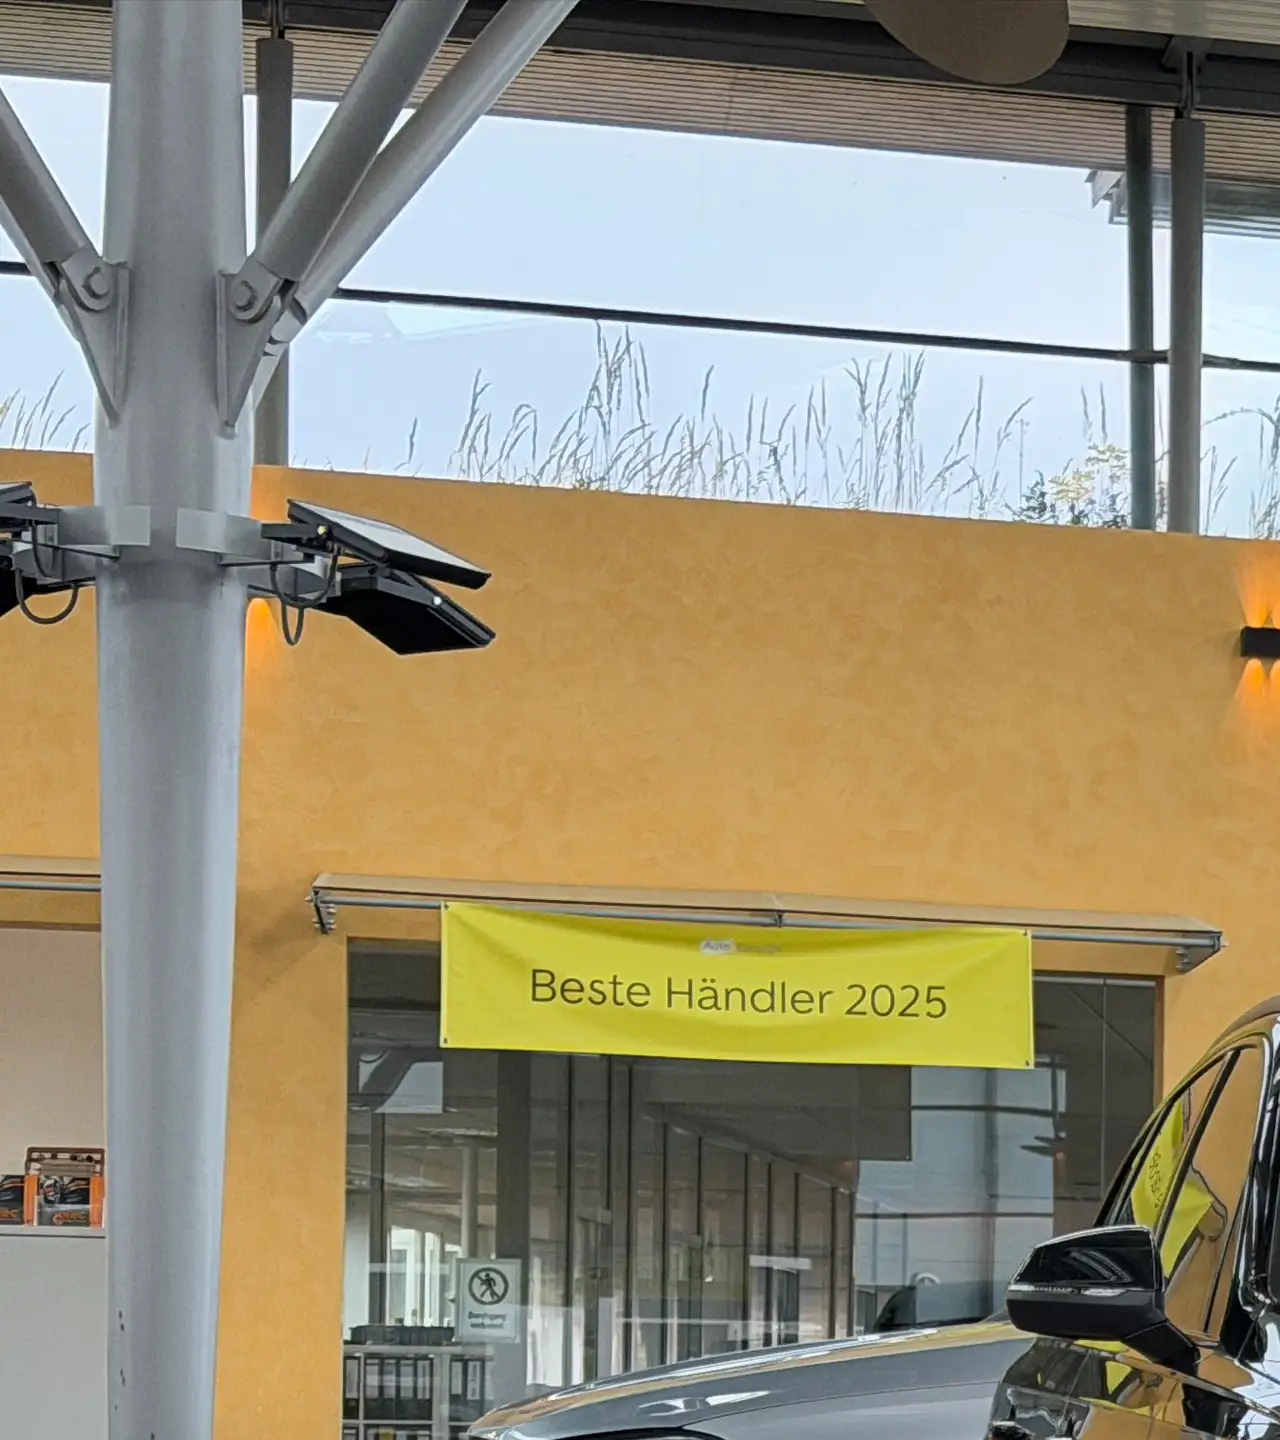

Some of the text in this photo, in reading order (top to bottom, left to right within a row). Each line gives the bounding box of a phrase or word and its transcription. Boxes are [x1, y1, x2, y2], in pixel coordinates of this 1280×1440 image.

[531, 968, 948, 1019] Beste Händler 2025
